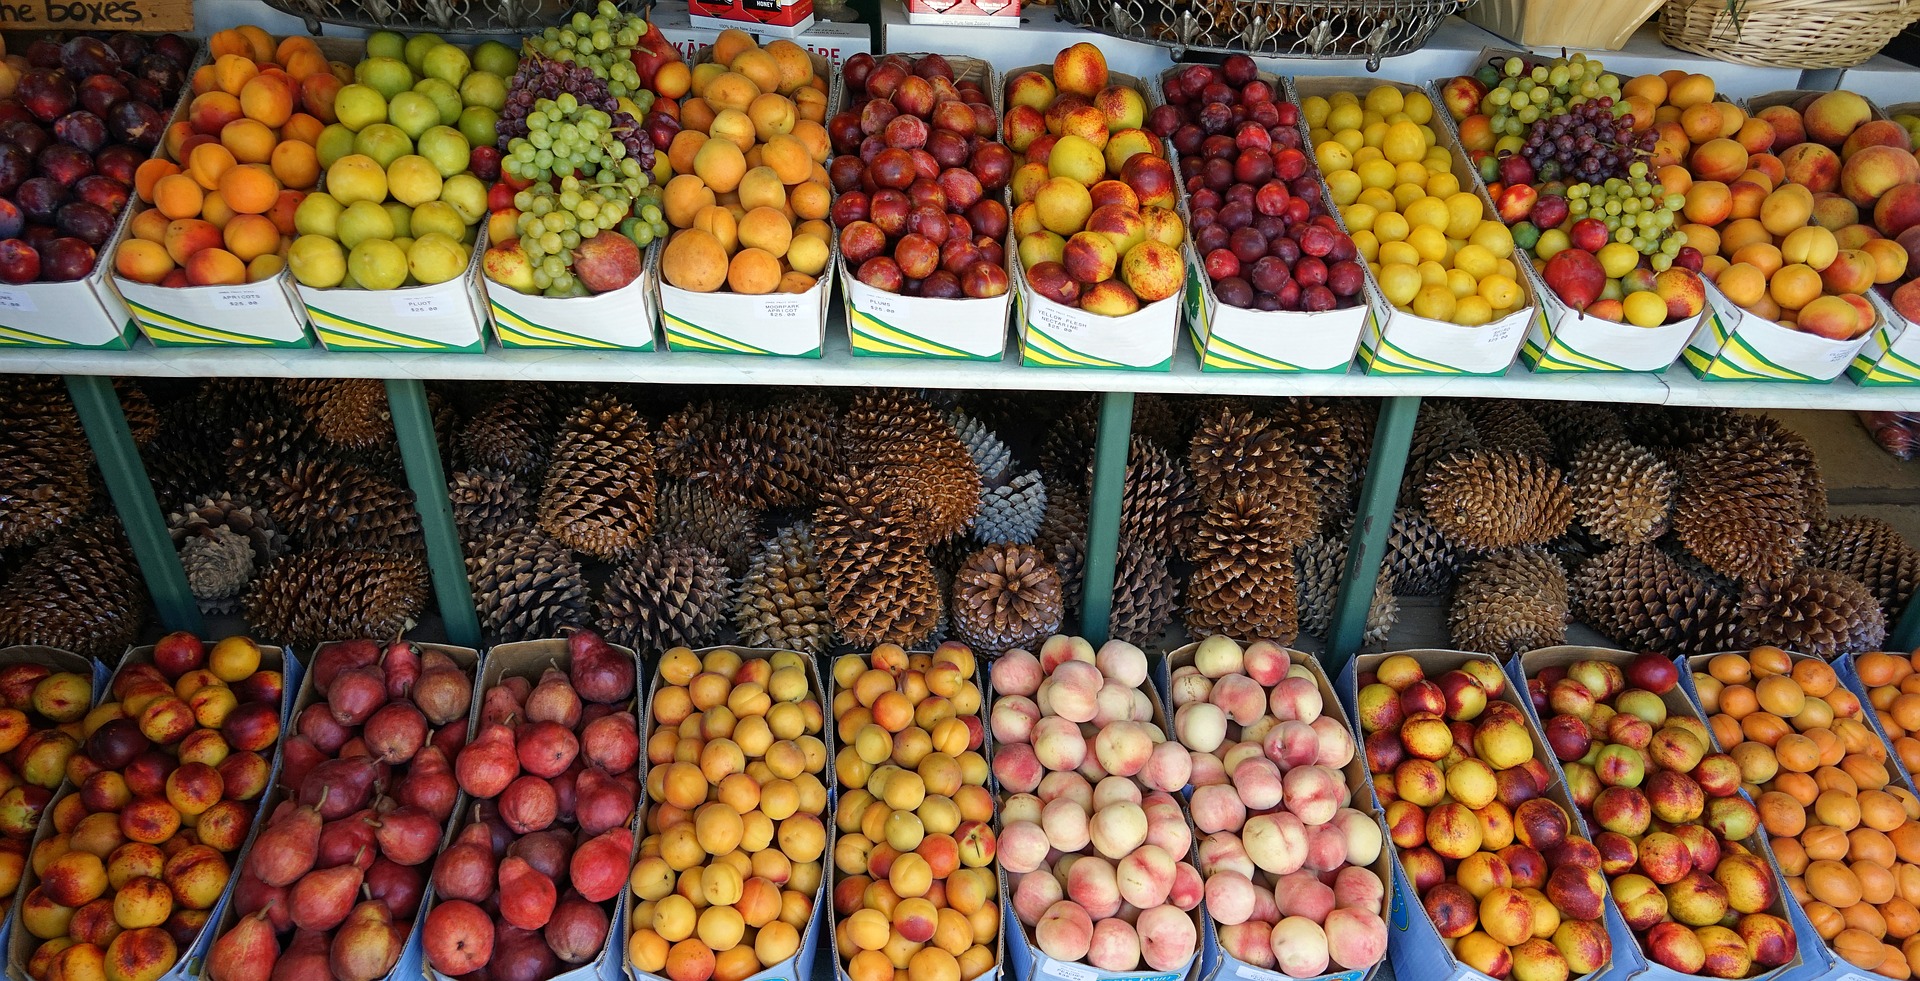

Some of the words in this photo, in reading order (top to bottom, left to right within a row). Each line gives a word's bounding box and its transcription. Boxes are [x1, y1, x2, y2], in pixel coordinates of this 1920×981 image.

[44, 0, 144, 25] boxes
[869, 299, 891, 307] PLUMS
[1037, 309, 1062, 321] YELLOW
[1065, 318, 1087, 328] FLESH
[1041, 316, 1079, 330] NECTARINE
